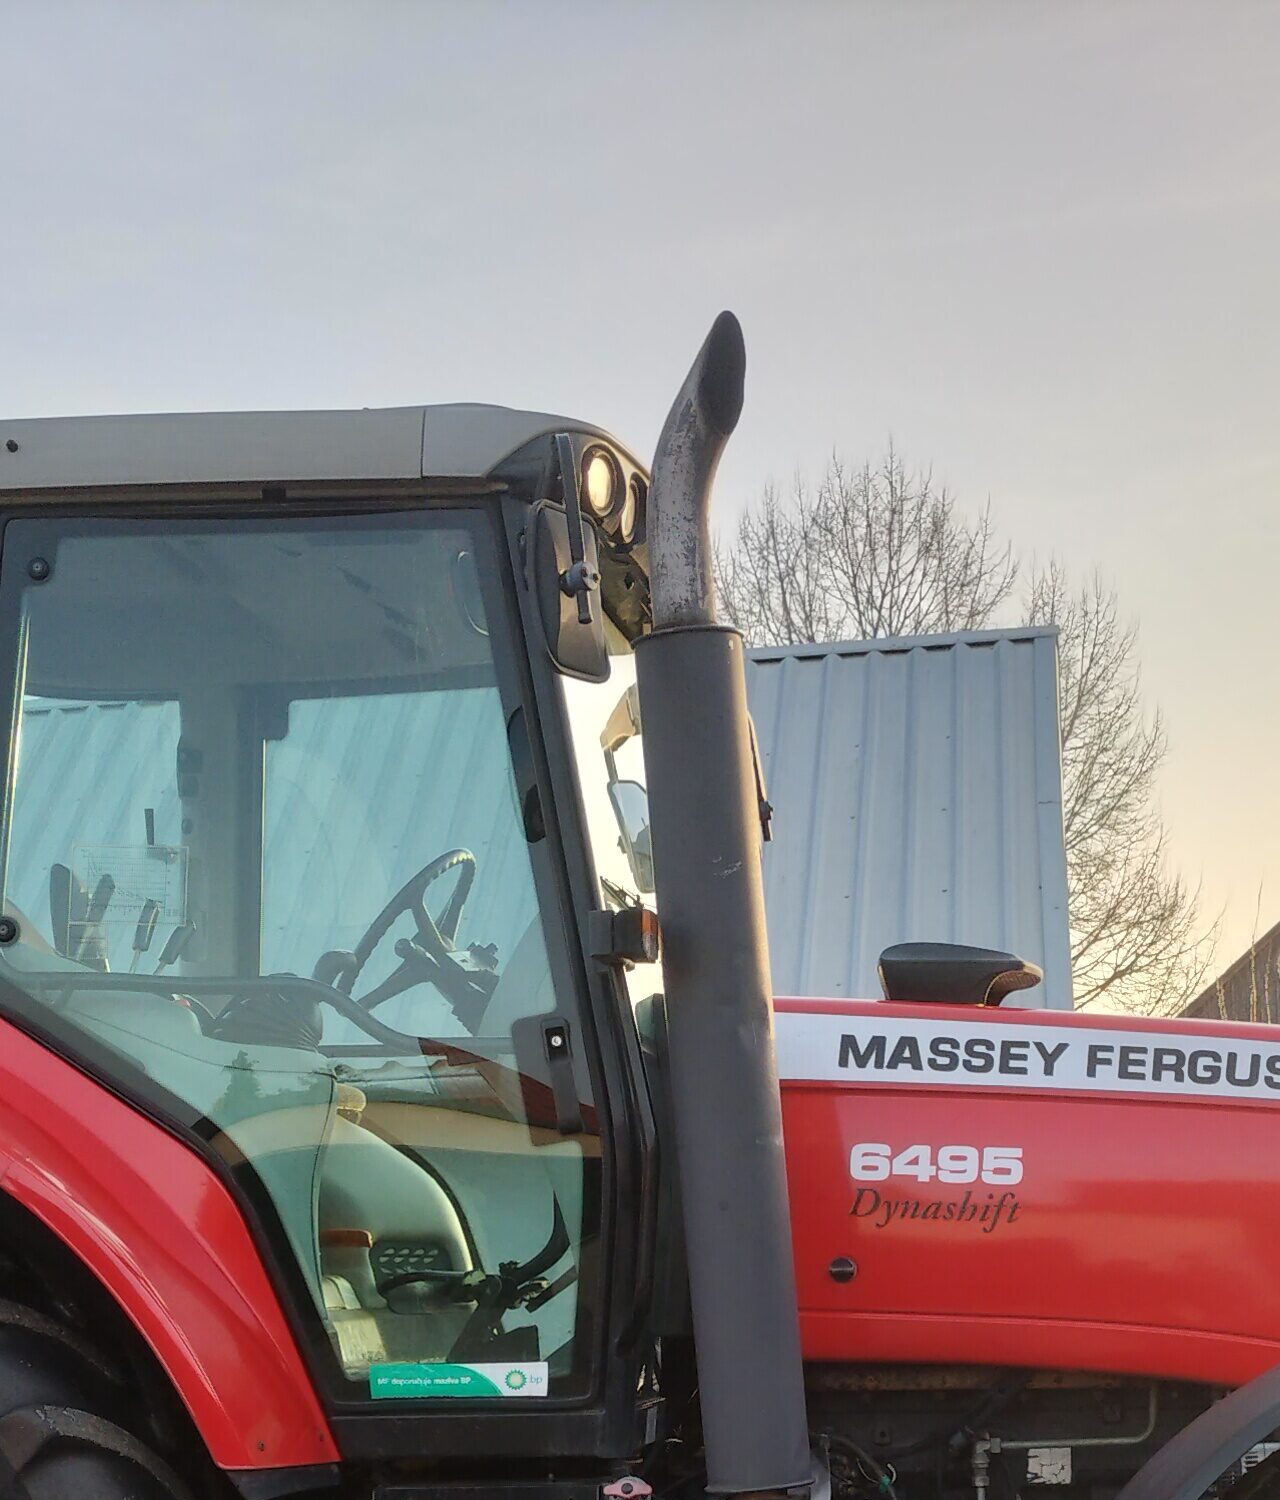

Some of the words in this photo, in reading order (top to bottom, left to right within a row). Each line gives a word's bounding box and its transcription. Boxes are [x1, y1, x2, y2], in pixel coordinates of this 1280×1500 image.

[837, 1033, 1070, 1077] MASSEY
[849, 1143, 1024, 1186] 6495
[848, 1187, 1023, 1234] Dynashift
[529, 1375, 543, 1386] bp
